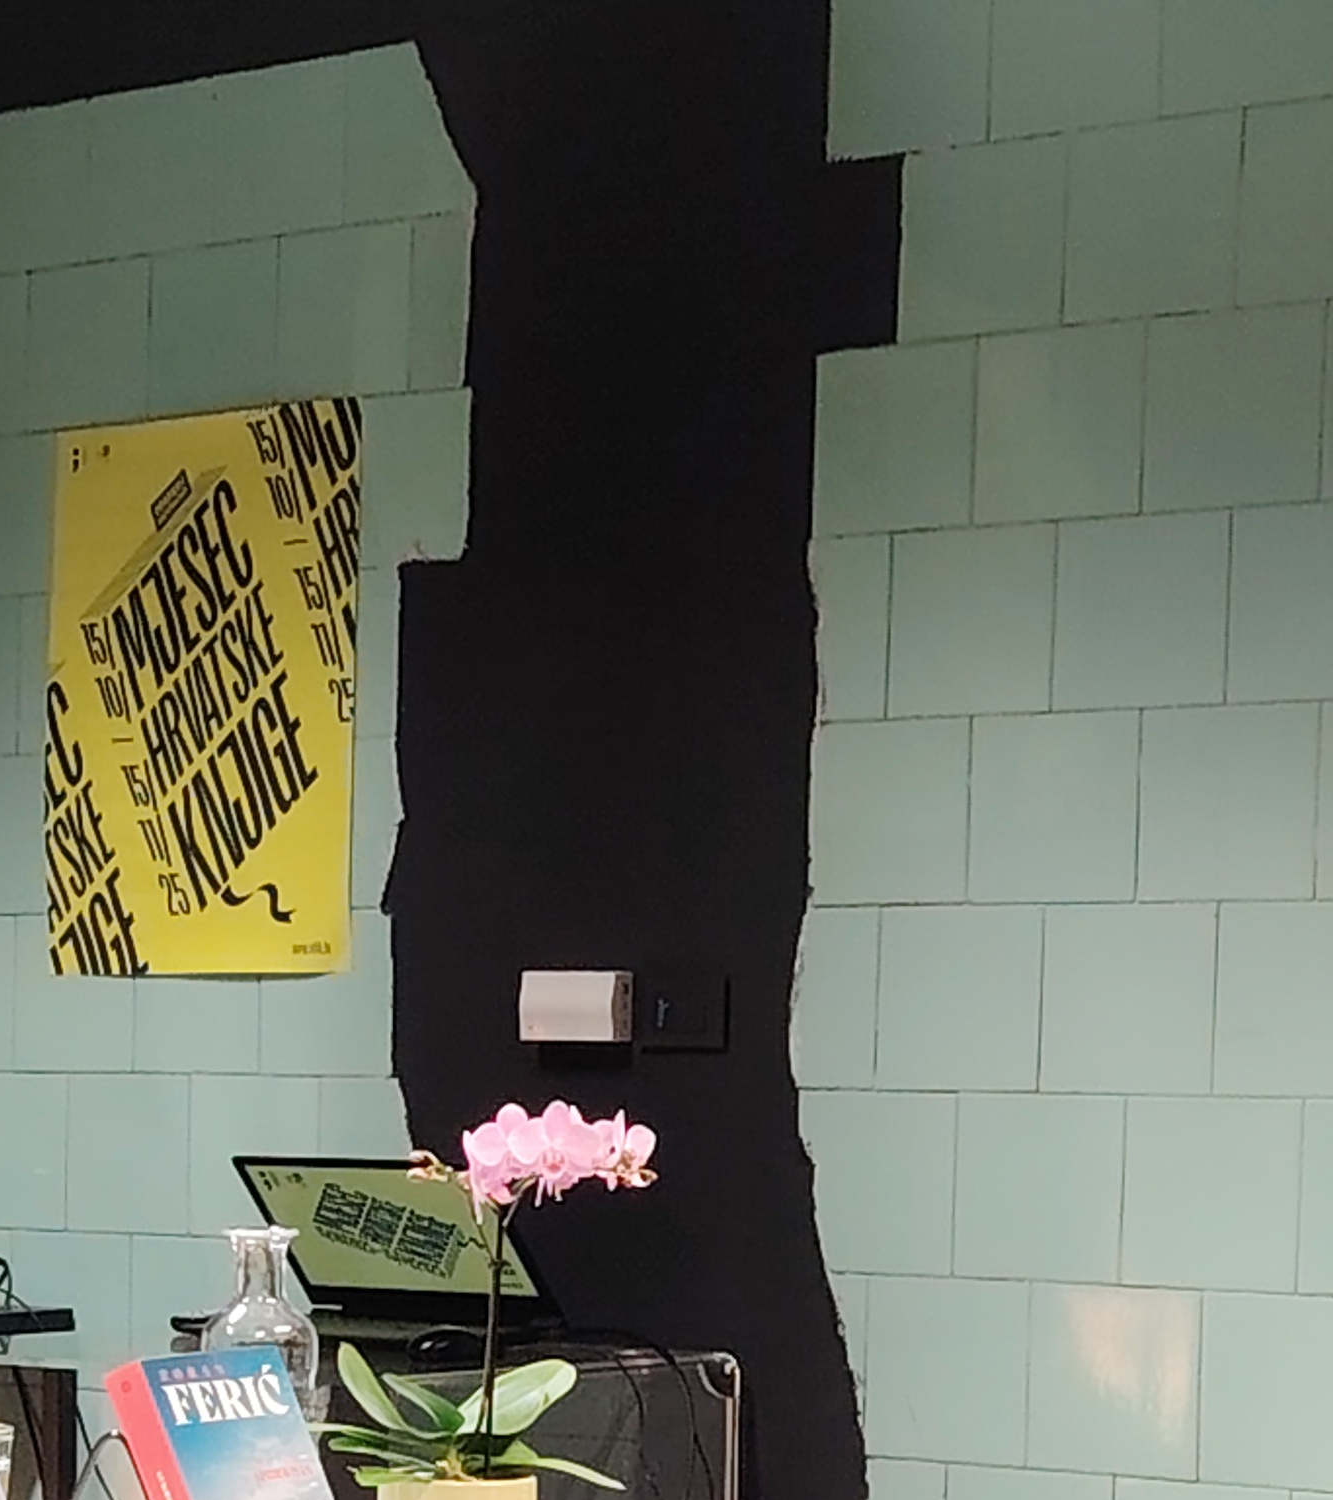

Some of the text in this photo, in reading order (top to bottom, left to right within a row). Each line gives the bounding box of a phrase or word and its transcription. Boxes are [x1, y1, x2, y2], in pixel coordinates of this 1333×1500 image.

[279, 397, 363, 512] MJ
[112, 479, 254, 713] MJESEC
[313, 474, 361, 600] HR
[44, 681, 84, 823] EC
[140, 579, 285, 798] HRVATSKE
[168, 669, 320, 912] KNJIGE
[158, 873, 191, 917] 25
[160, 1364, 290, 1426] FERIĆ
